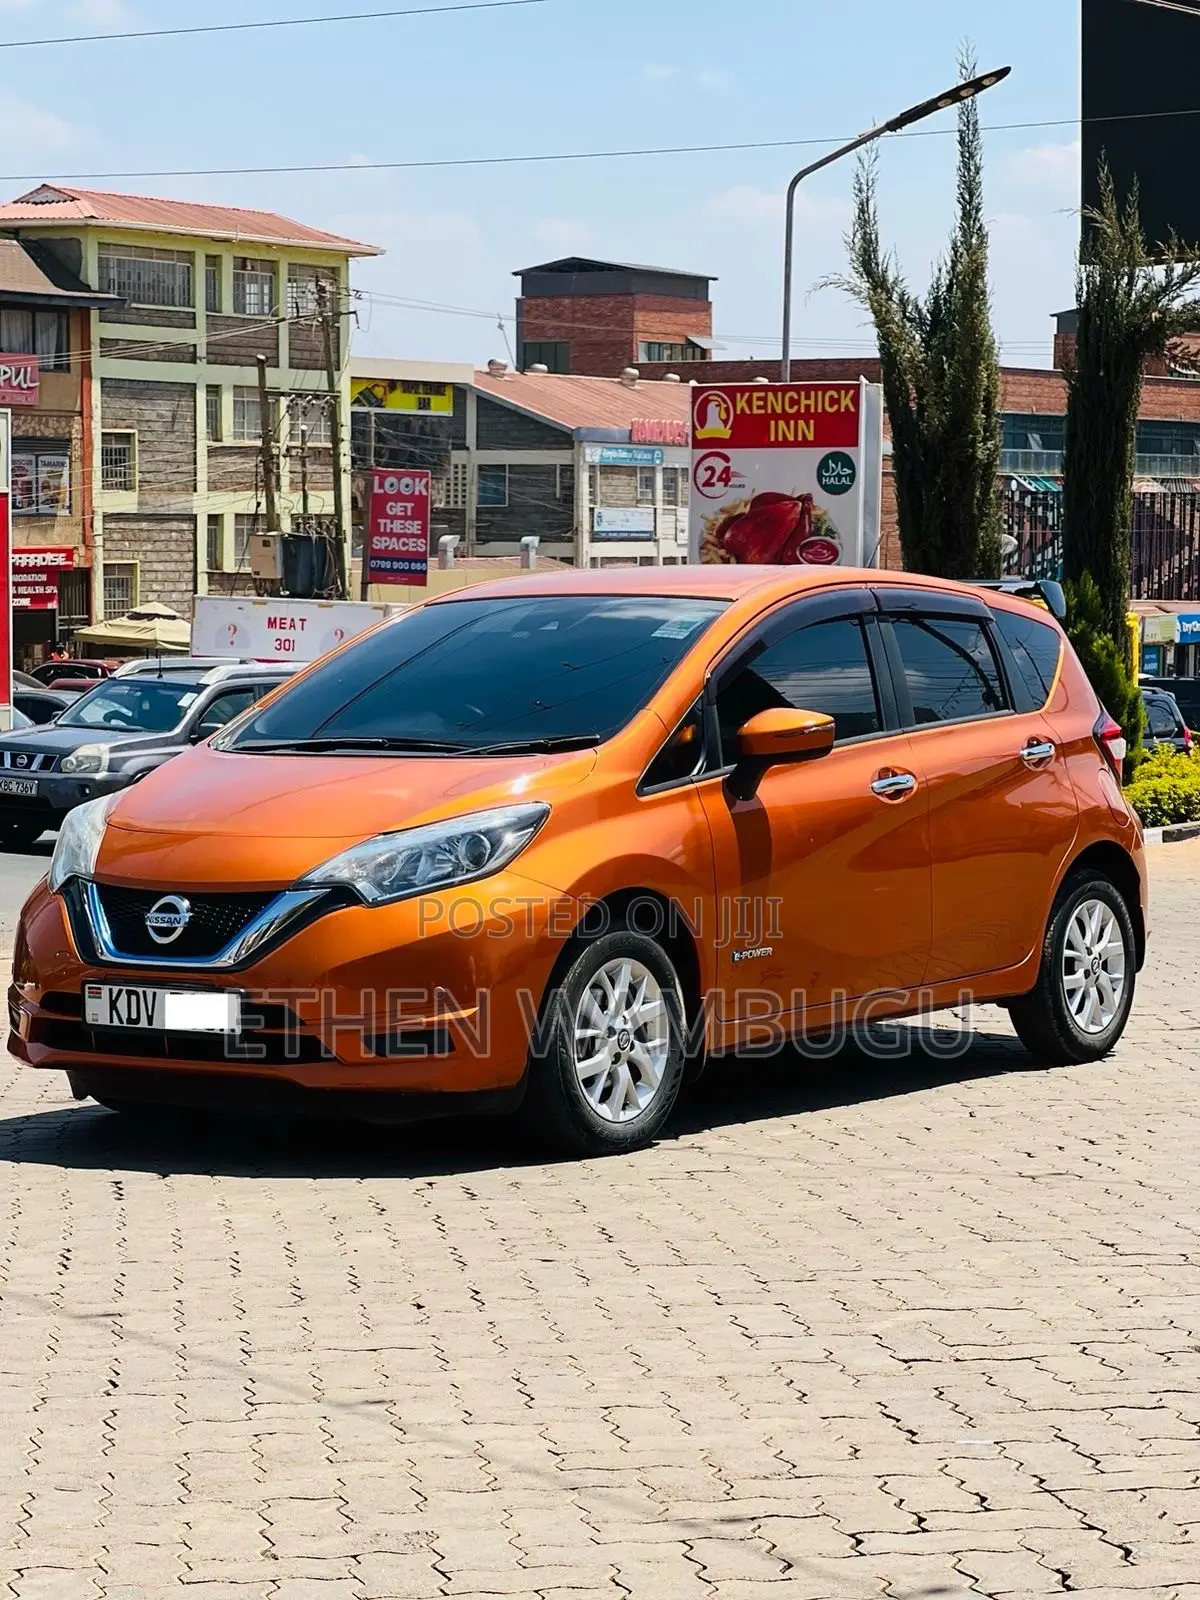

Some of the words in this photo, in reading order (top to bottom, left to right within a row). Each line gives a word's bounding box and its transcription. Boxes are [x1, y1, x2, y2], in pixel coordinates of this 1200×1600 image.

[736, 390, 856, 414] KENCHICK
[769, 420, 815, 441] INN
[822, 459, 852, 476] حلال
[702, 466, 732, 488] 24
[822, 477, 852, 485] HALAL
[373, 476, 428, 496] LOOK
[386, 502, 415, 516] GET
[377, 519, 422, 534] THESE
[372, 536, 426, 552] SPACES
[17, 586, 44, 594] HEALTH
[45, 586, 58, 594] SPA
[267, 617, 307, 631] MEAT
[274, 638, 296, 652] 301
[146, 914, 182, 926] NISSAN
[733, 947, 773, 961] e-POWER
[108, 988, 157, 1027] KDV
